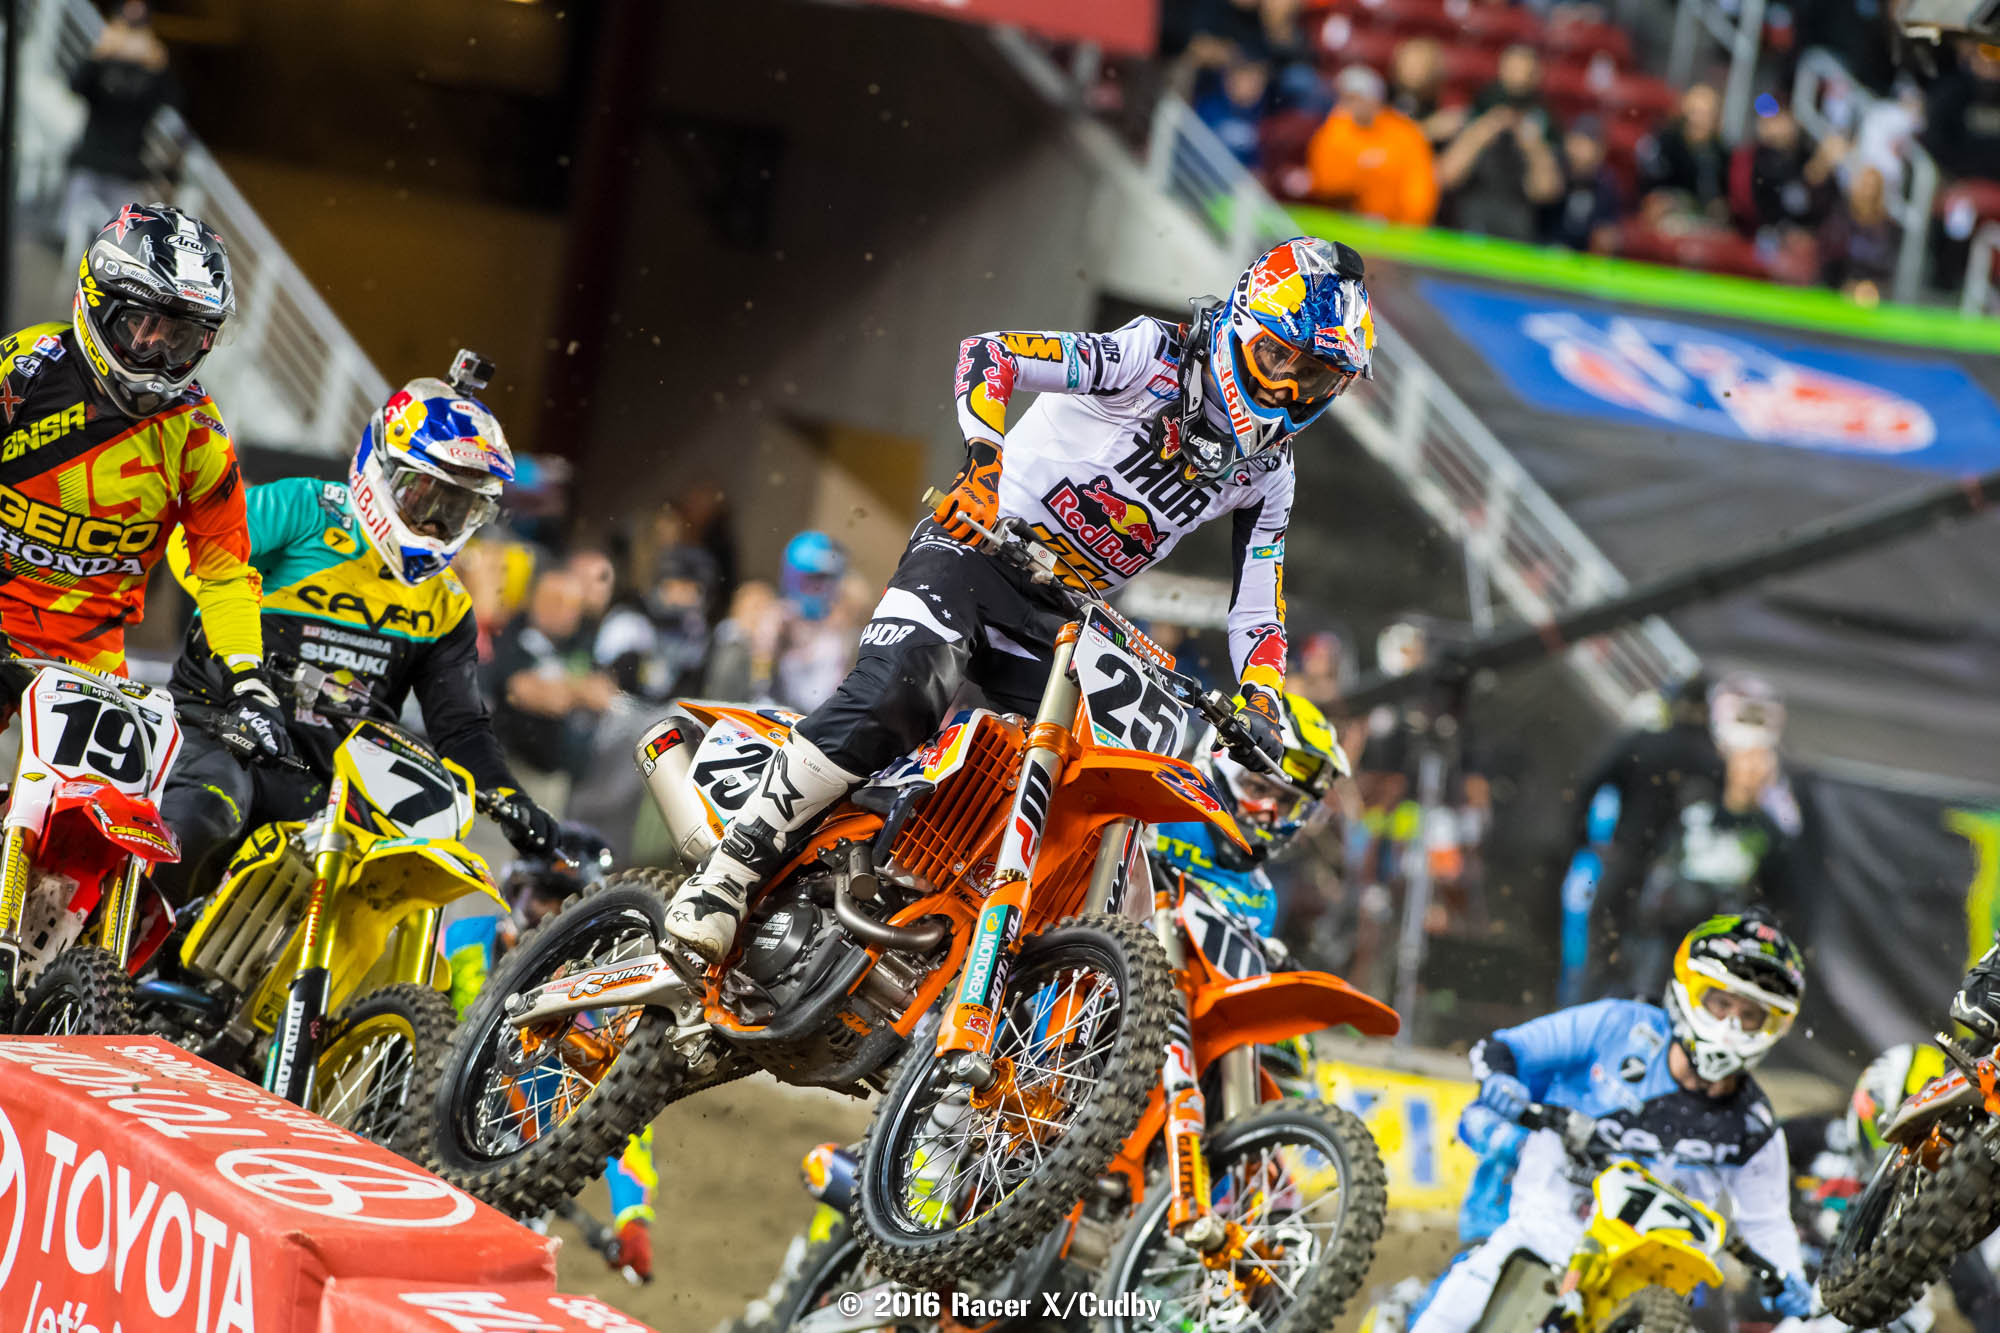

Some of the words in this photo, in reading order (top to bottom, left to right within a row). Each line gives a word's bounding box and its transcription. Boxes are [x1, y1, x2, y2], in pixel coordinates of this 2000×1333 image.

[76, 308, 109, 377] GEICO
[1223, 379, 1253, 437] Bull
[0, 485, 161, 553] GEICO
[356, 486, 392, 542] Bull
[1049, 484, 1111, 547] Red
[1094, 535, 1151, 577] Bull
[0, 528, 145, 577] HONDA
[299, 641, 390, 676] SUZUKI
[1086, 652, 1185, 759] 25
[50, 698, 158, 784] 19
[387, 758, 458, 828] 7
[108, 825, 178, 855] GEICO
[966, 933, 998, 1002] MOTOREX
[274, 999, 306, 1099] DUNLOP
[40, 1129, 255, 1333] TOYOTA
